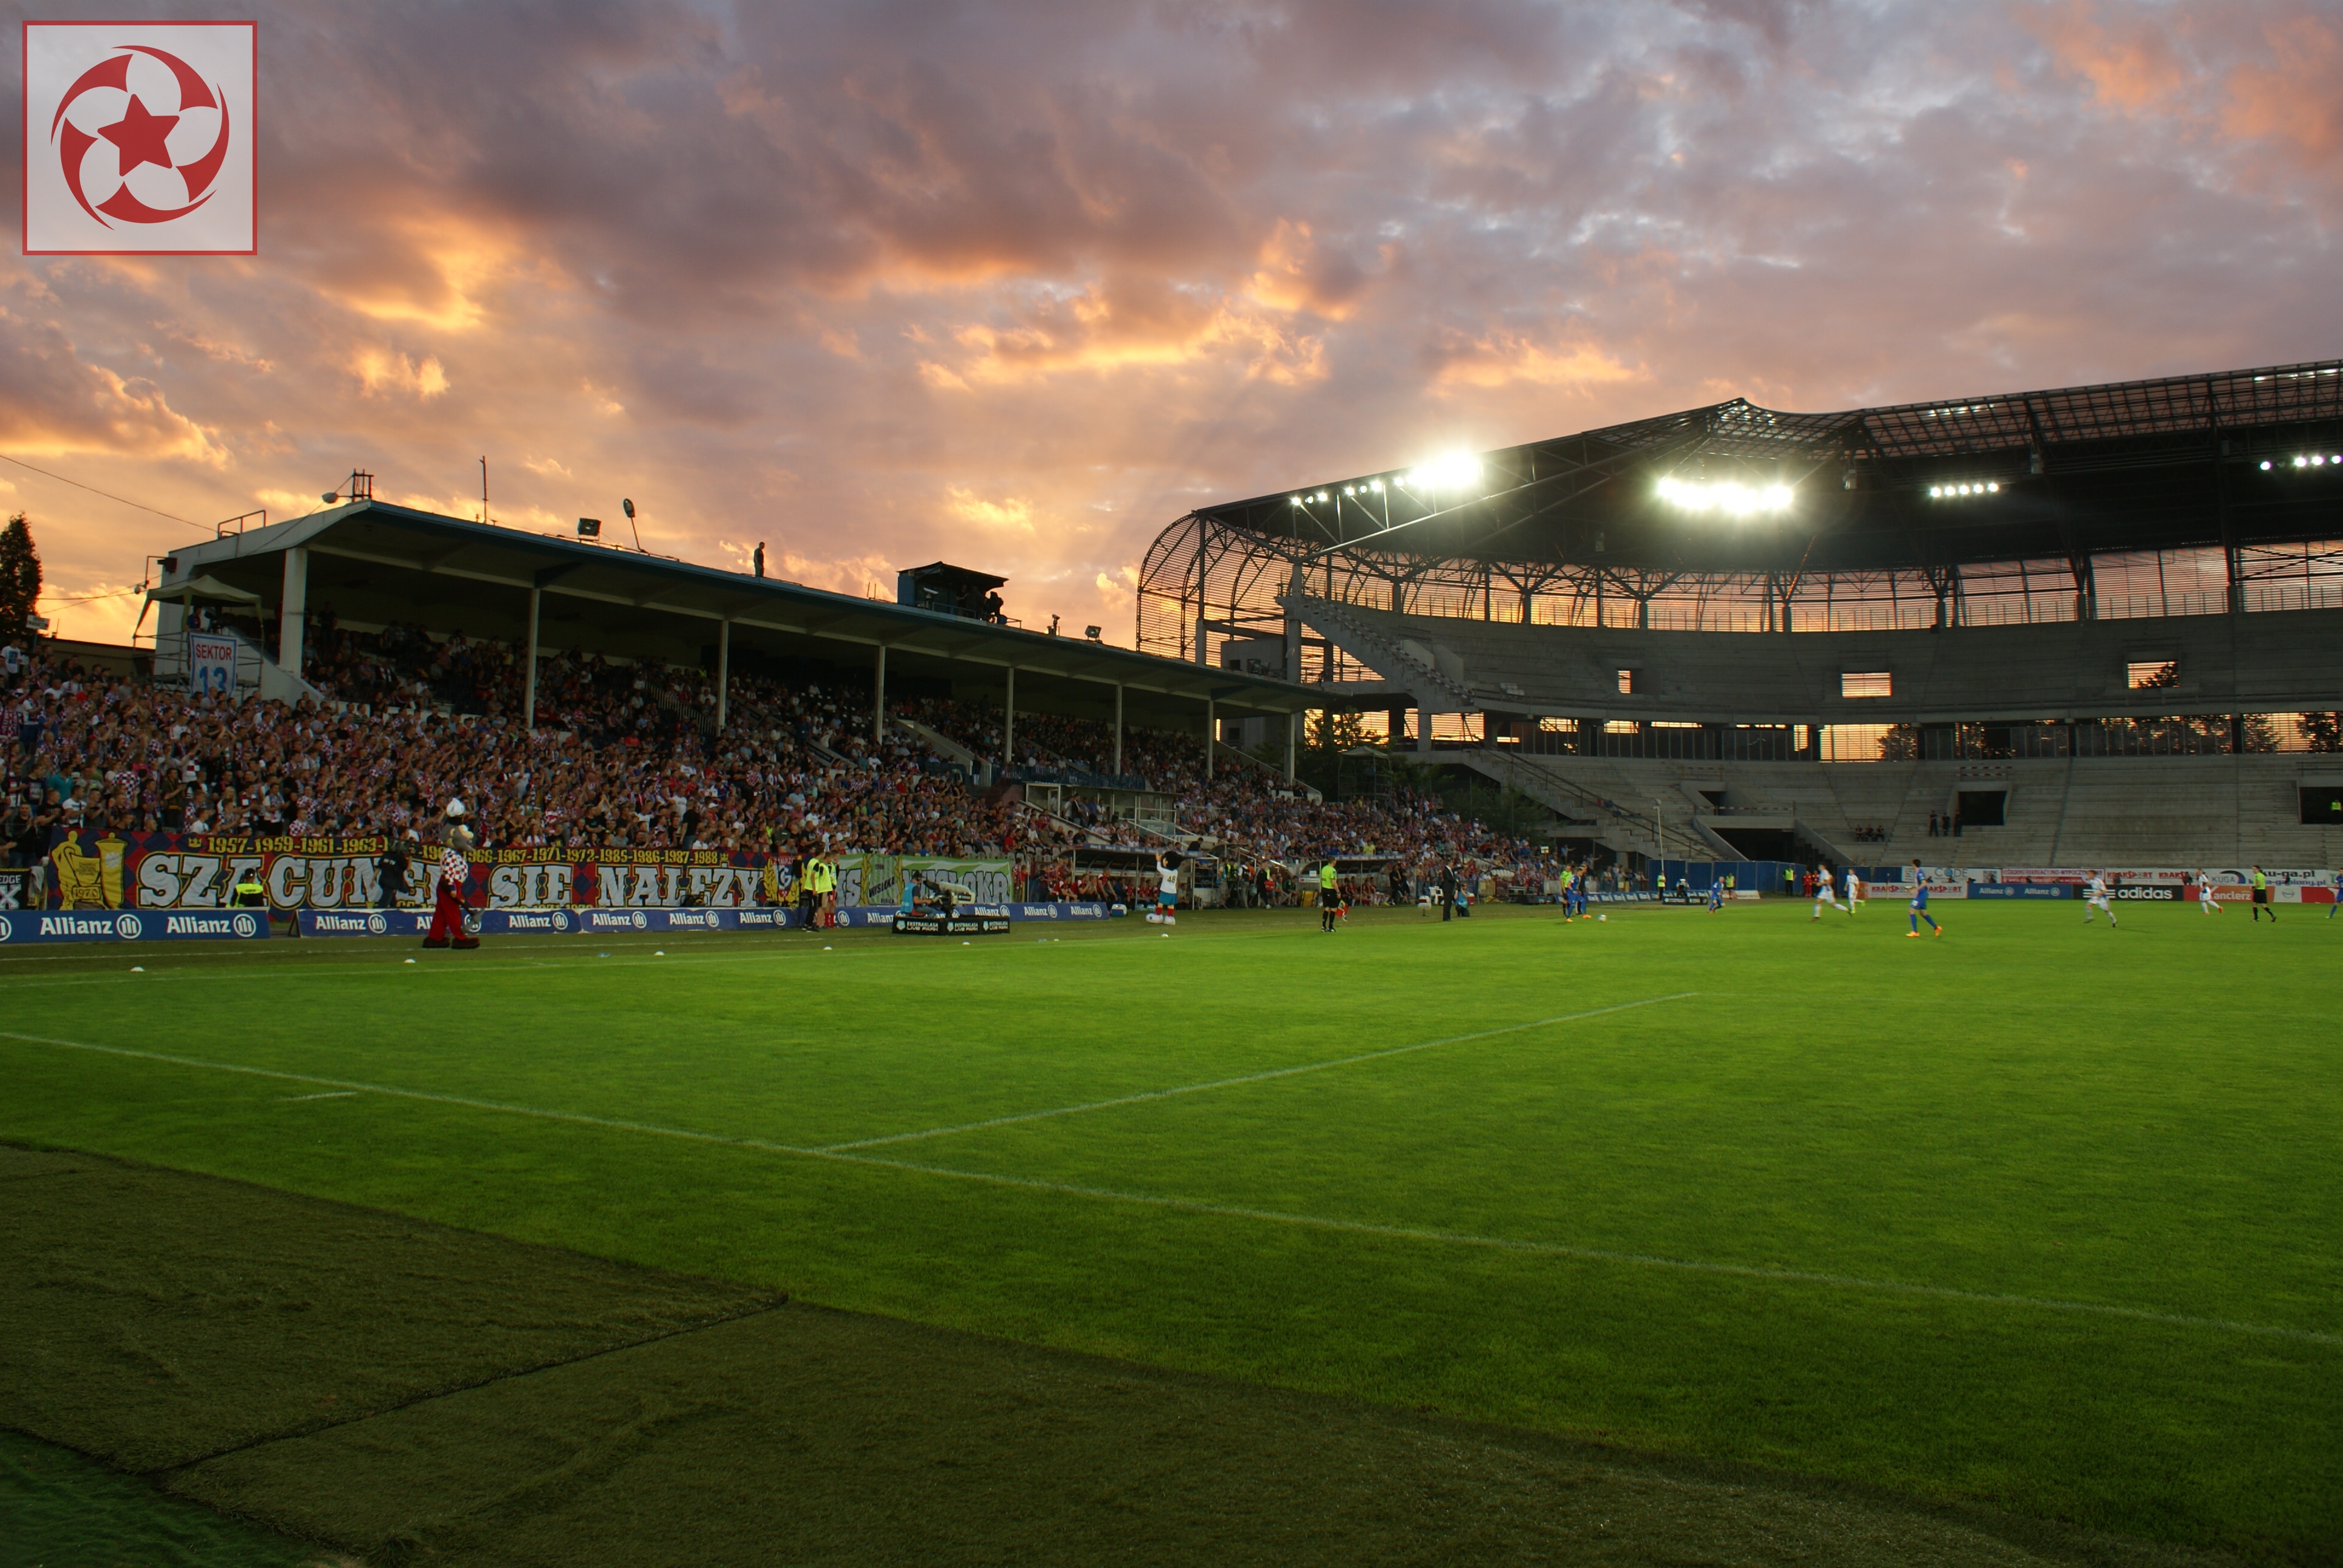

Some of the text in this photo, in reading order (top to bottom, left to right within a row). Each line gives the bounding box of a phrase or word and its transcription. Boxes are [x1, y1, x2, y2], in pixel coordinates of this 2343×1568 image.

[196, 644, 232, 661] SEKTOR
[199, 666, 228, 697] 13
[74, 888, 98, 900] 1970
[2118, 887, 2174, 900] adidas
[739, 911, 773, 924] Allianz
[974, 907, 1000, 917] Allianz
[1024, 906, 1048, 916] Allianz
[1070, 906, 1094, 916] Allianz
[40, 916, 113, 936] Allianz
[166, 916, 231, 935] Allianz
[315, 915, 367, 930] Allianz
[509, 915, 551, 929] Allianz
[592, 913, 632, 927] Allianz
[669, 912, 705, 926] Allianz
